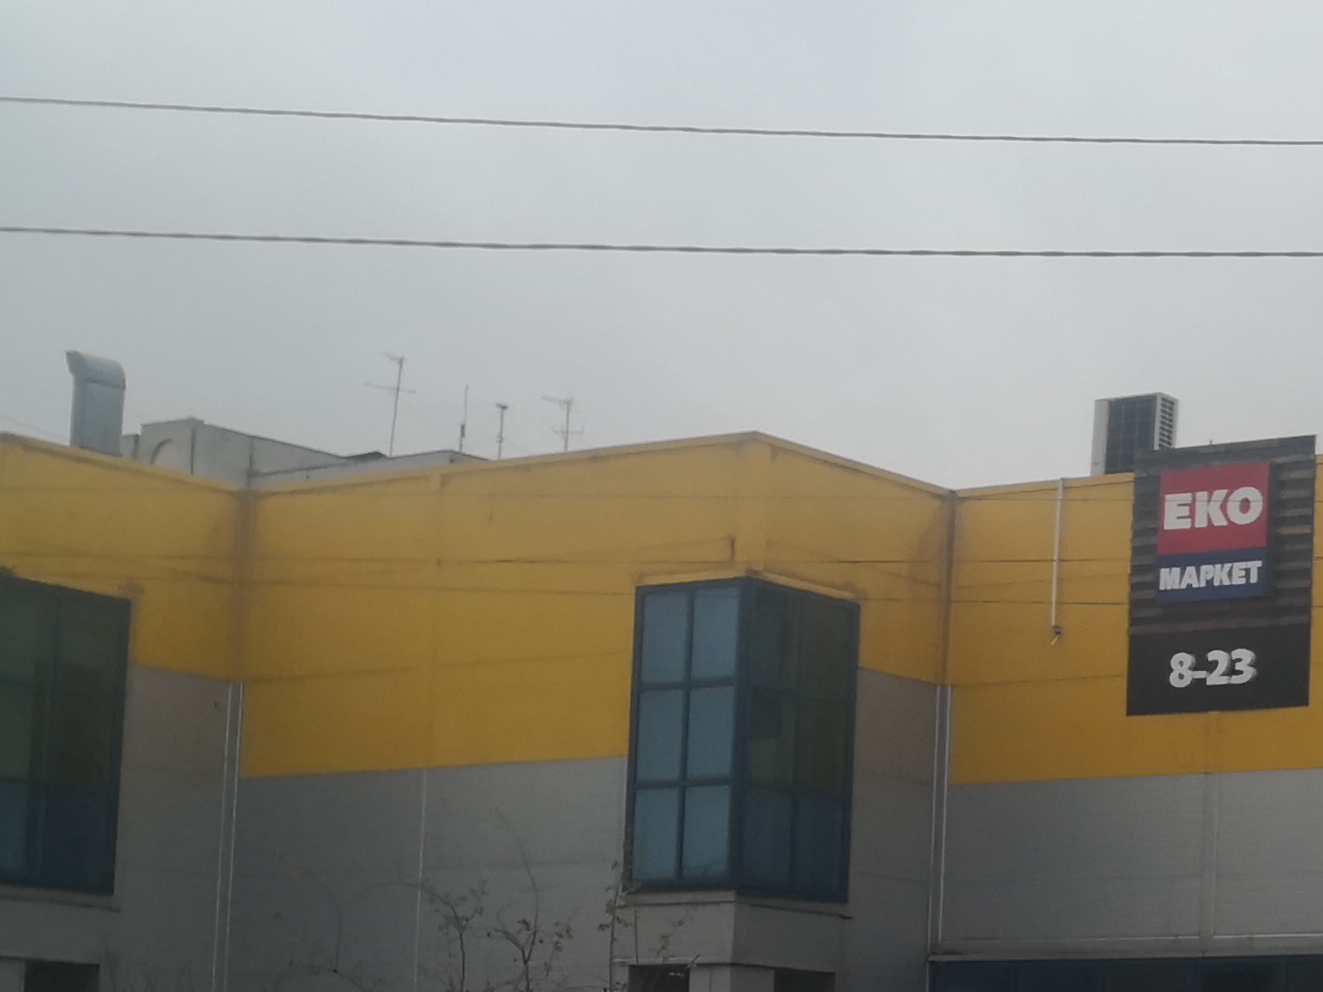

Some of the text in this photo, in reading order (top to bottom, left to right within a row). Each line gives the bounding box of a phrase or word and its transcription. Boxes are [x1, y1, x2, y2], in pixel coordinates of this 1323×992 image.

[1162, 486, 1264, 530] ЕКО
[1158, 560, 1263, 591] МАРКЕТ
[1169, 648, 1256, 688] 8-23
